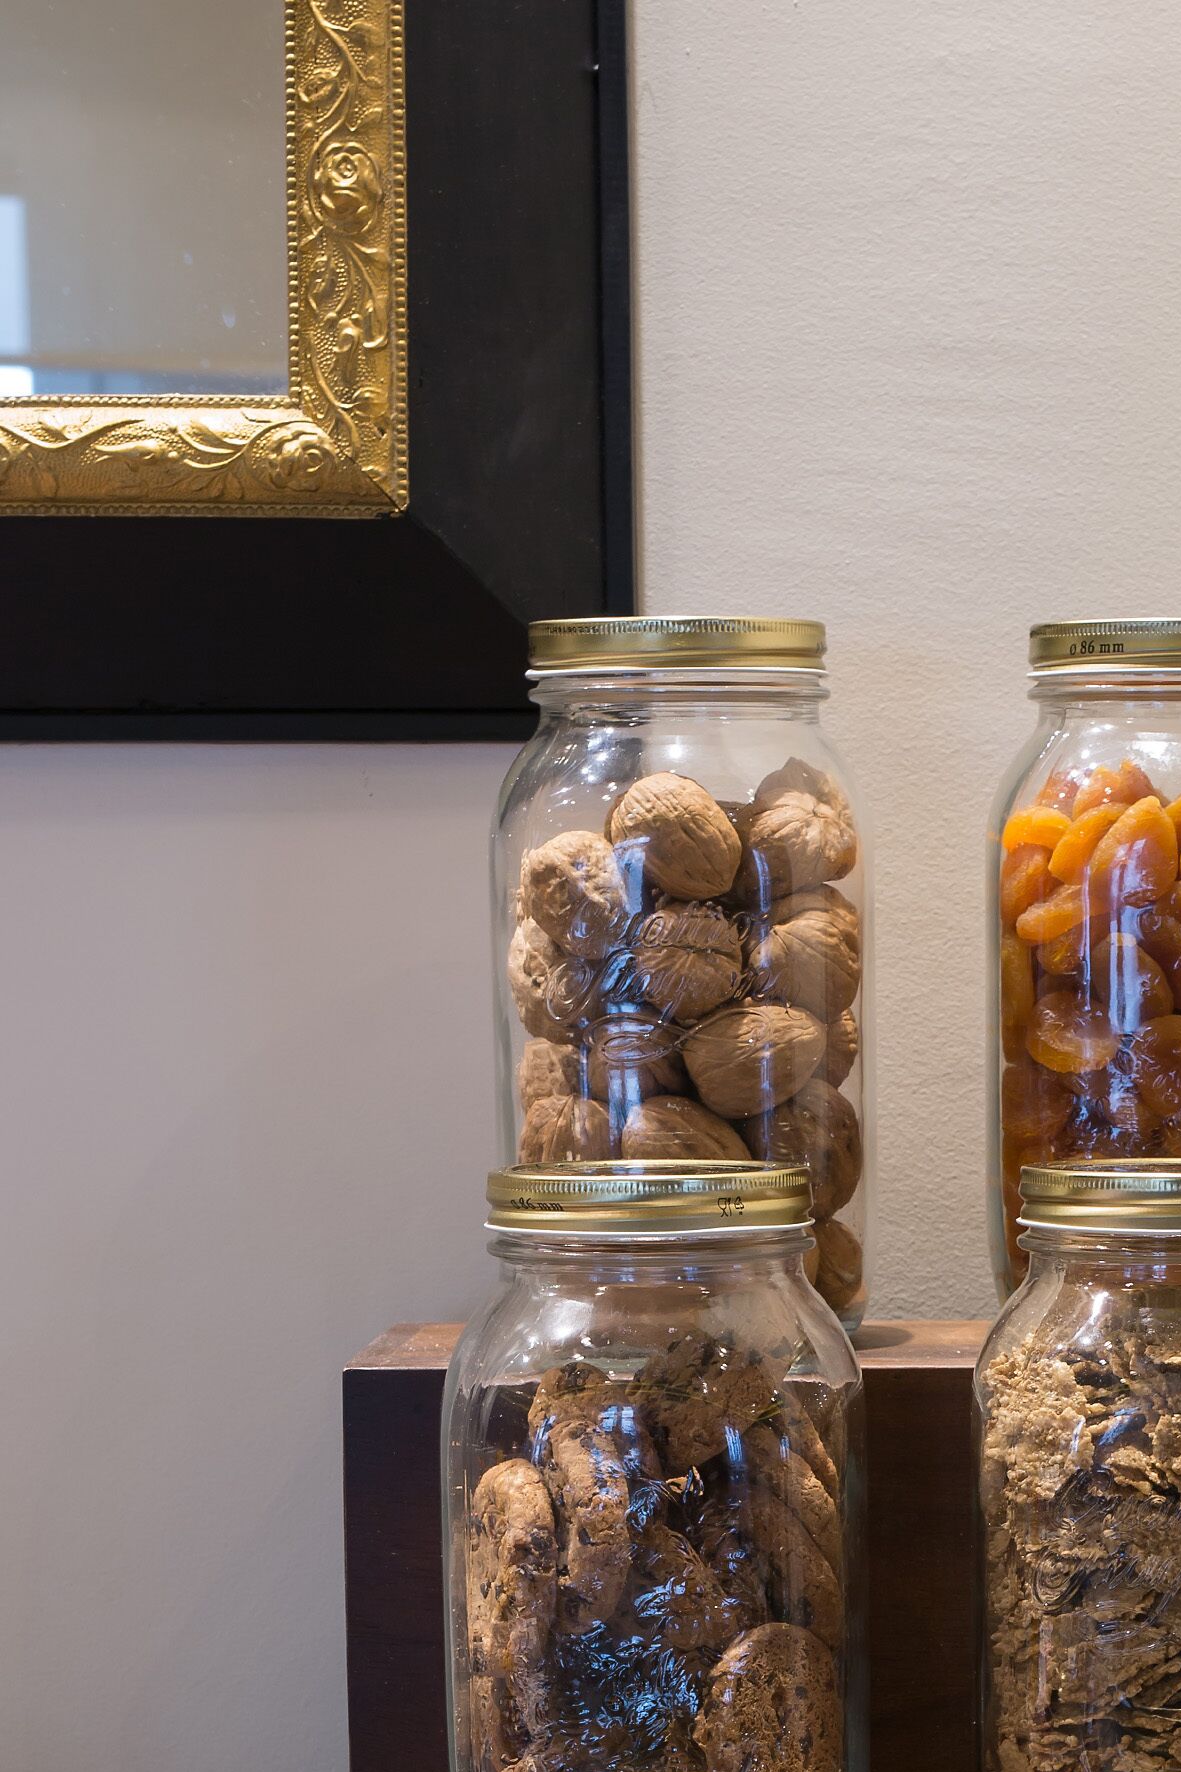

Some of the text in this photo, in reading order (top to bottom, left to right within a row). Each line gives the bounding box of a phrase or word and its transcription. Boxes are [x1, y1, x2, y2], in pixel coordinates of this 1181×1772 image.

[1080, 639, 1095, 655] 86
[1099, 642, 1124, 654] mm
[519, 1196, 536, 1210] 86
[537, 1202, 564, 1212] mm
